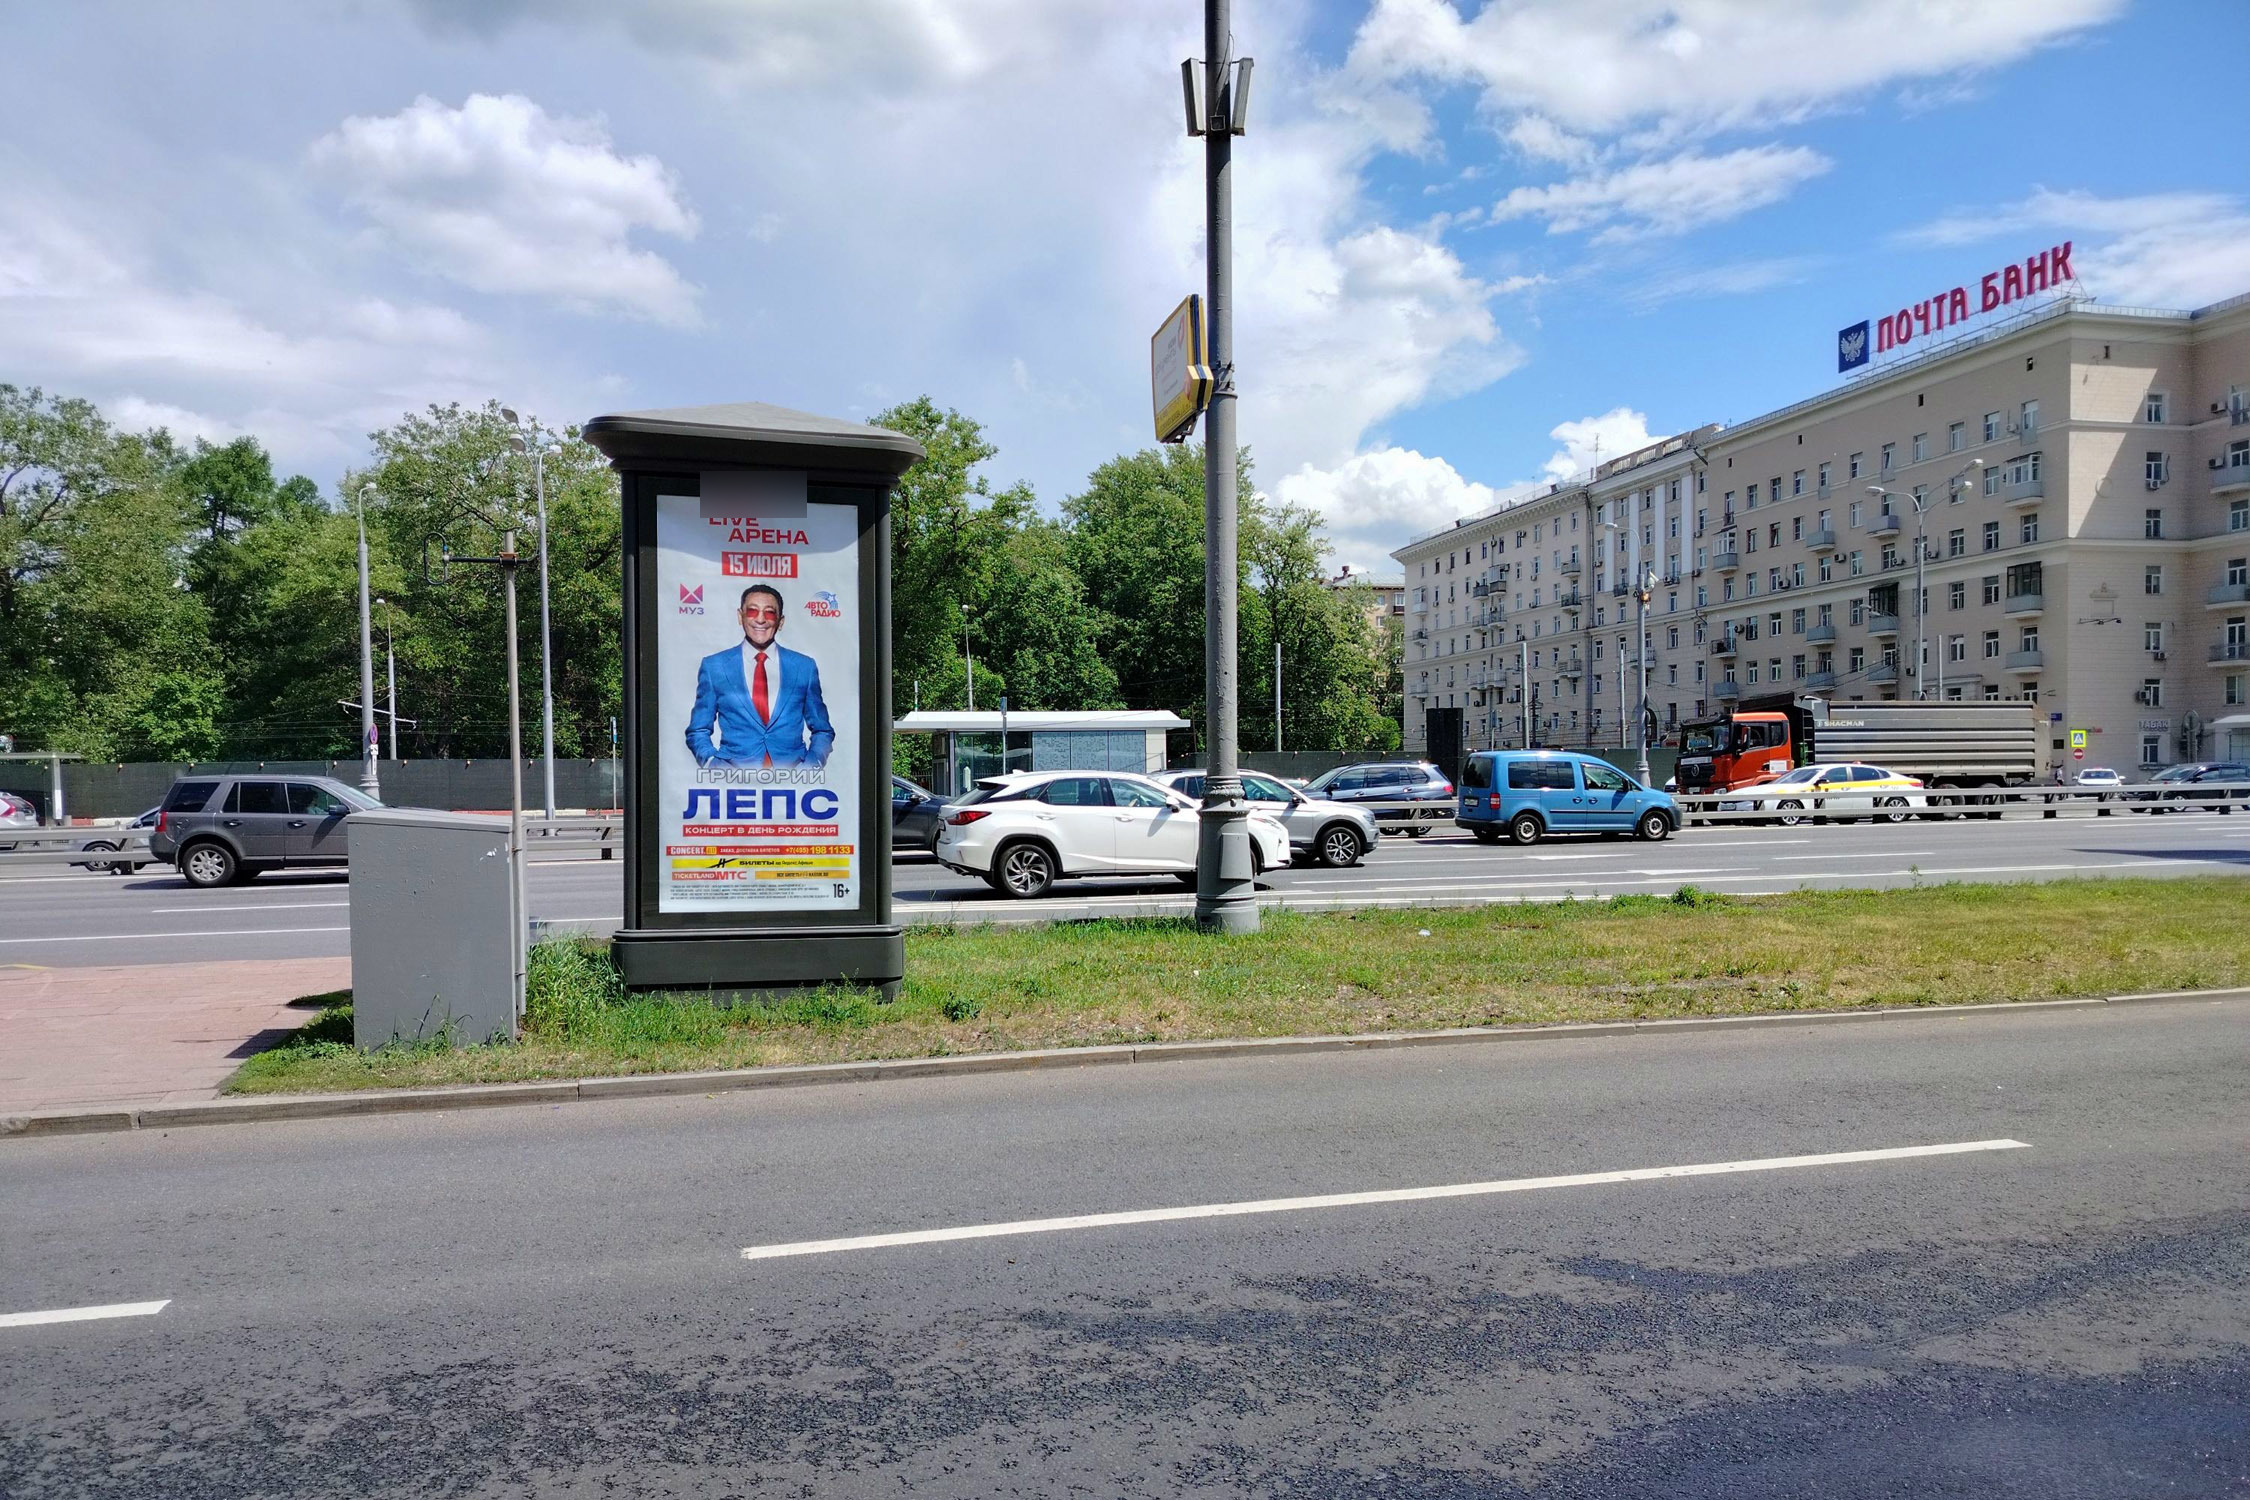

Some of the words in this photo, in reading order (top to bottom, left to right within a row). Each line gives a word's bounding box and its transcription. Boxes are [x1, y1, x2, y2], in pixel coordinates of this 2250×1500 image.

[1877, 287, 1969, 353] ПОЧТА
[1981, 241, 2074, 313] БАНК
[728, 527, 809, 545] АРЕНА
[728, 554, 744, 574] 15
[747, 555, 792, 576] ИЮЛЯ
[679, 606, 705, 615] МУЗ
[804, 601, 828, 609] АВТО
[811, 609, 841, 618] РАДИО
[696, 767, 826, 785] ГРИГОРИЙ
[682, 788, 839, 821] ЛЕПС
[685, 826, 733, 835] КОНЦЕРТ
[748, 827, 775, 835] ДЕНЬ
[778, 826, 837, 835] РОЖДЕНИЯ
[810, 846, 827, 854] 198
[829, 845, 851, 854] 1133
[833, 883, 851, 899] 16+
